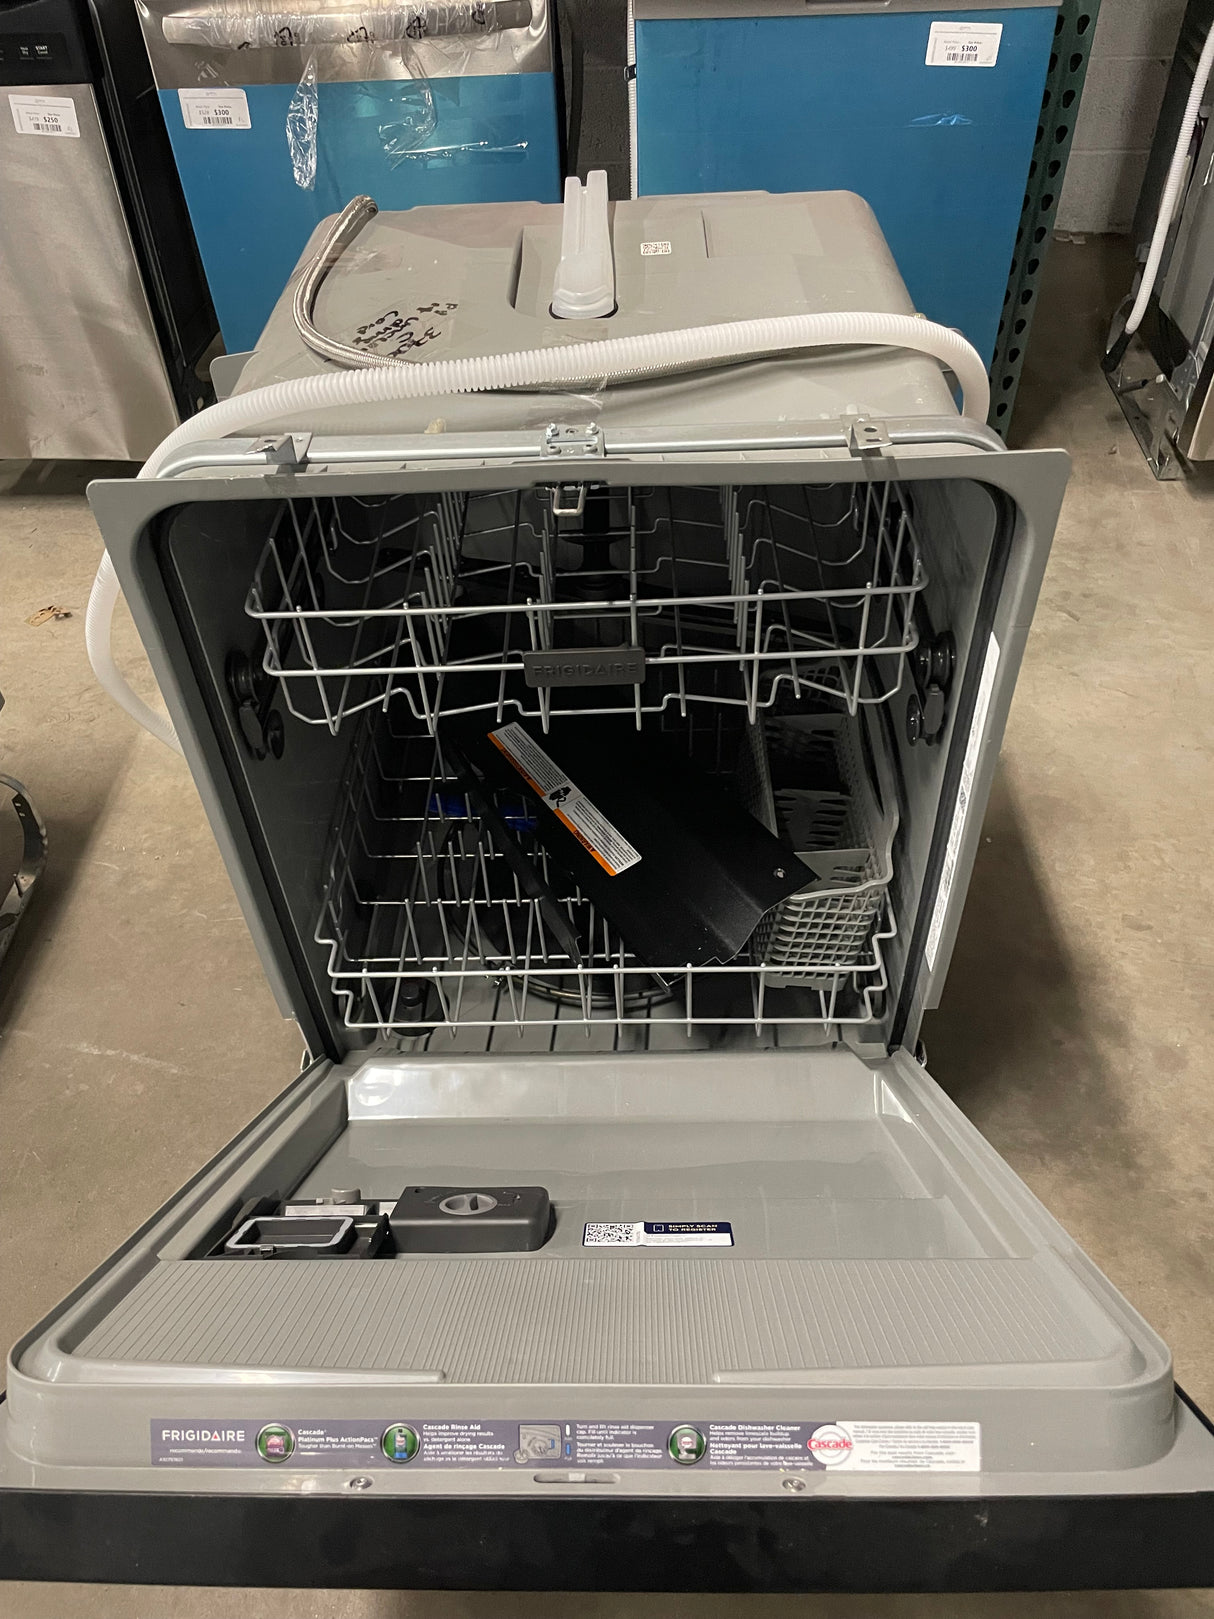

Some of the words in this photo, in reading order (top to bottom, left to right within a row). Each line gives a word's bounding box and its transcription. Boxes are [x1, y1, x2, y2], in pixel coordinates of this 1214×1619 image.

[532, 662, 638, 676] FRIGIDAIRE
[162, 1430, 245, 1441] FRIGIDAIRE
[807, 1438, 852, 1450] Cascade
